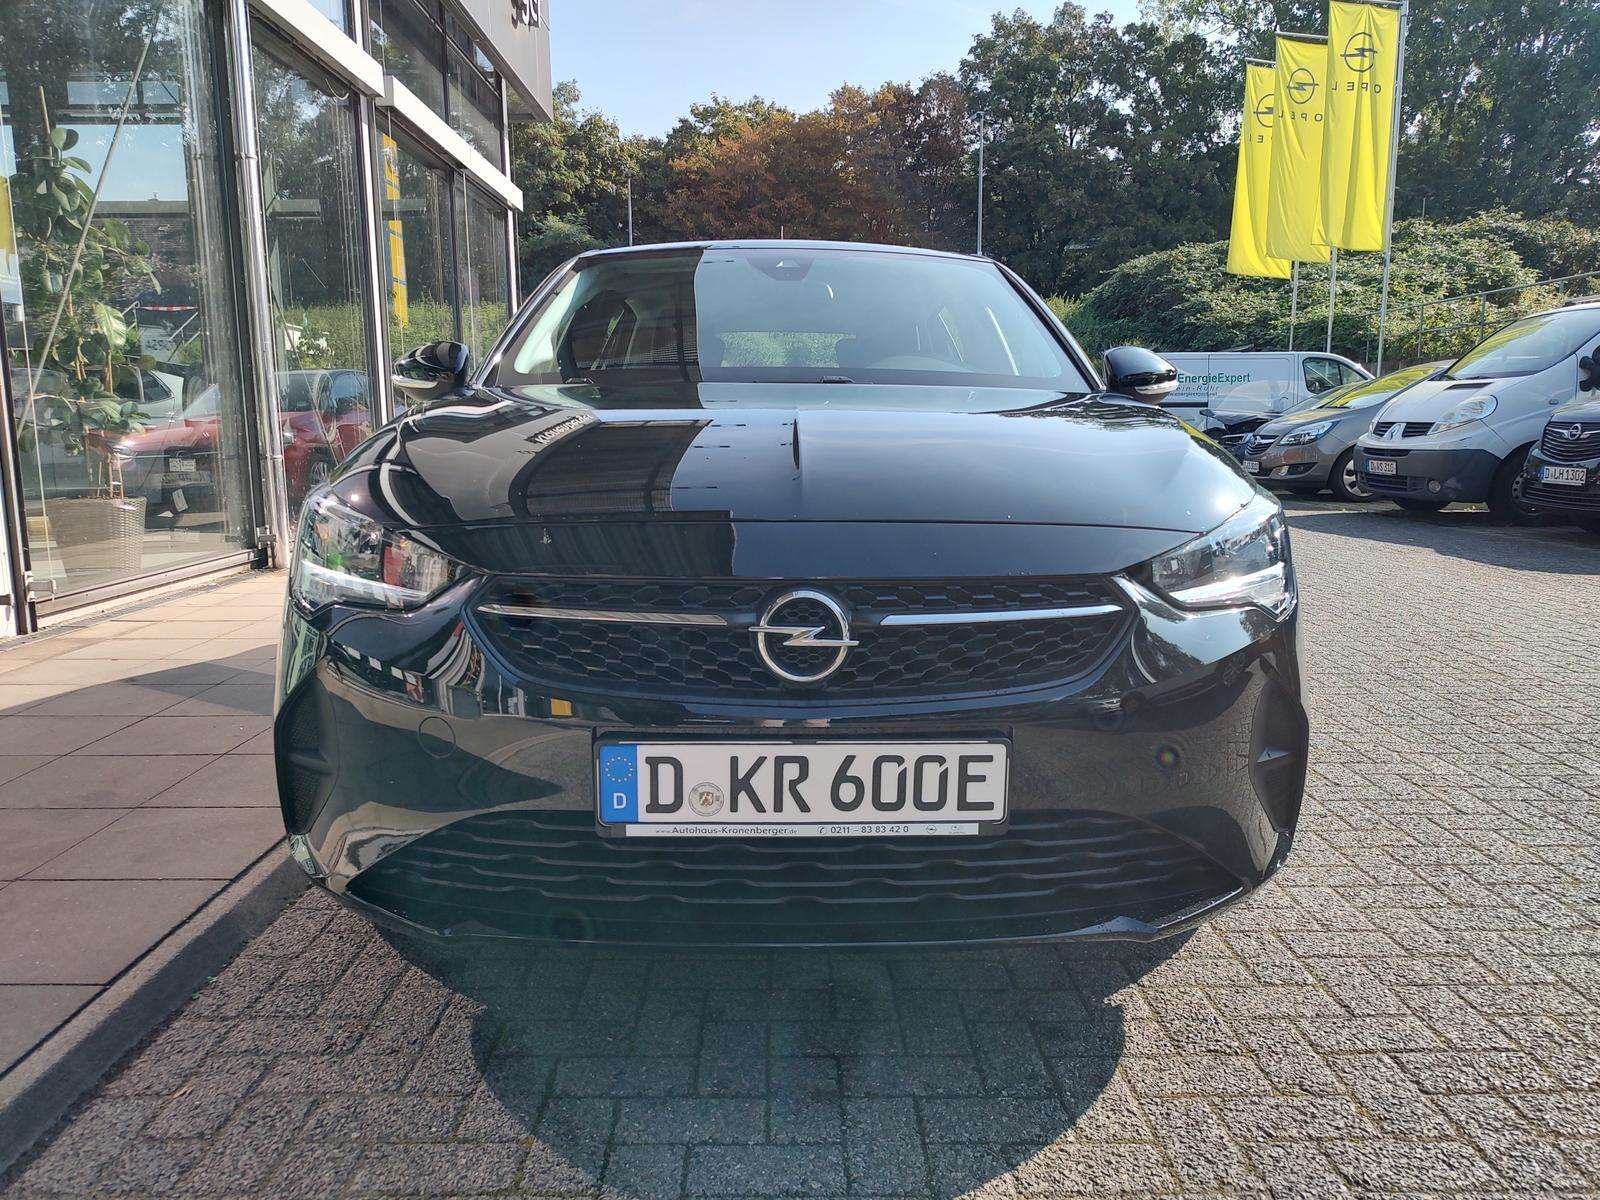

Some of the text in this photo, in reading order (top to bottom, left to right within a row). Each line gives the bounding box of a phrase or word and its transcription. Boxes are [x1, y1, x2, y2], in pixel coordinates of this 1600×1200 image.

[1177, 373, 1251, 386] EnergieExpert
[645, 755, 995, 813] D KR 600E
[613, 793, 627, 809] D
[830, 826, 850, 834] 0211
[861, 826, 873, 834] 83
[889, 825, 901, 833] 42
[903, 825, 909, 833] 0
